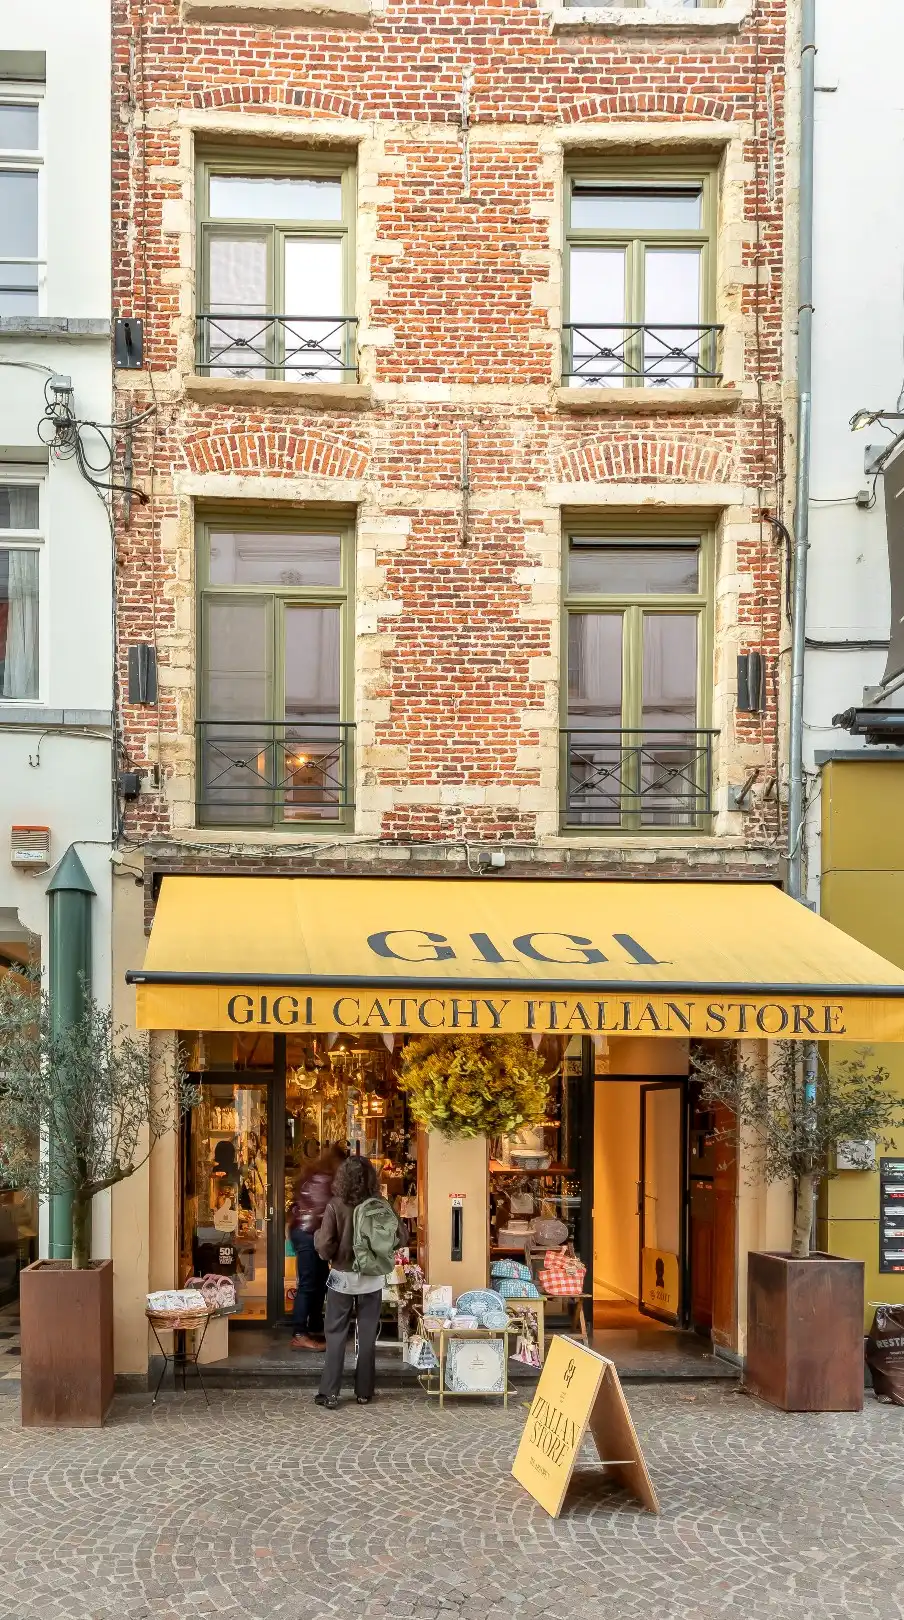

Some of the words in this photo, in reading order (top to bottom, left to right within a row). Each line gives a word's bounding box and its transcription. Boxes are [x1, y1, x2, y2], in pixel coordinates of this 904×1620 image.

[366, 929, 674, 965] GIGI
[227, 994, 317, 1026] GIGI
[332, 997, 512, 1029] CATCHY
[523, 1000, 696, 1032] ITALIAN
[705, 1003, 847, 1034] STORE
[303, 1138, 361, 1160] GGI
[531, 1395, 581, 1449] ITALIAN
[529, 1420, 570, 1467] STORE
